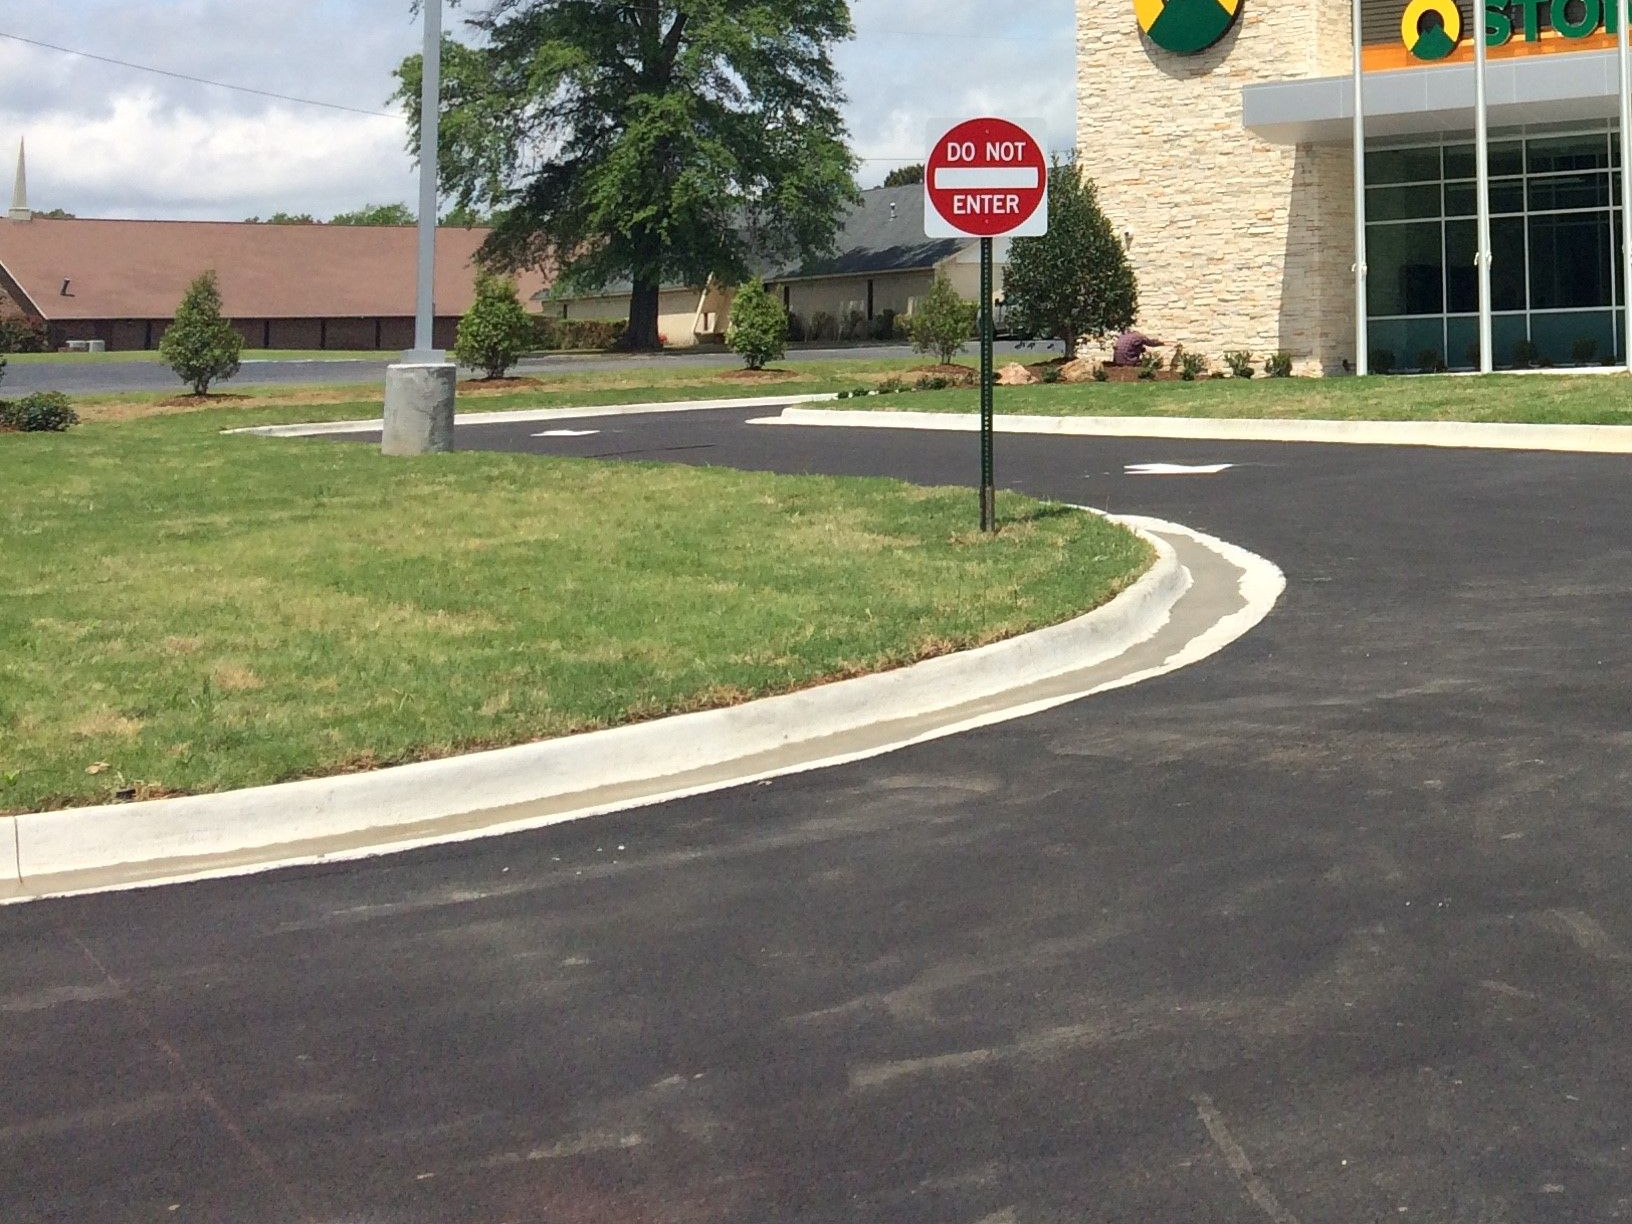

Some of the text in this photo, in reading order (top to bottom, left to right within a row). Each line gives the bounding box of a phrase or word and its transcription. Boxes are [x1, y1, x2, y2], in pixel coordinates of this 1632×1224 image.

[947, 142, 1026, 162] DO NOT
[953, 195, 1020, 214] ENTER
